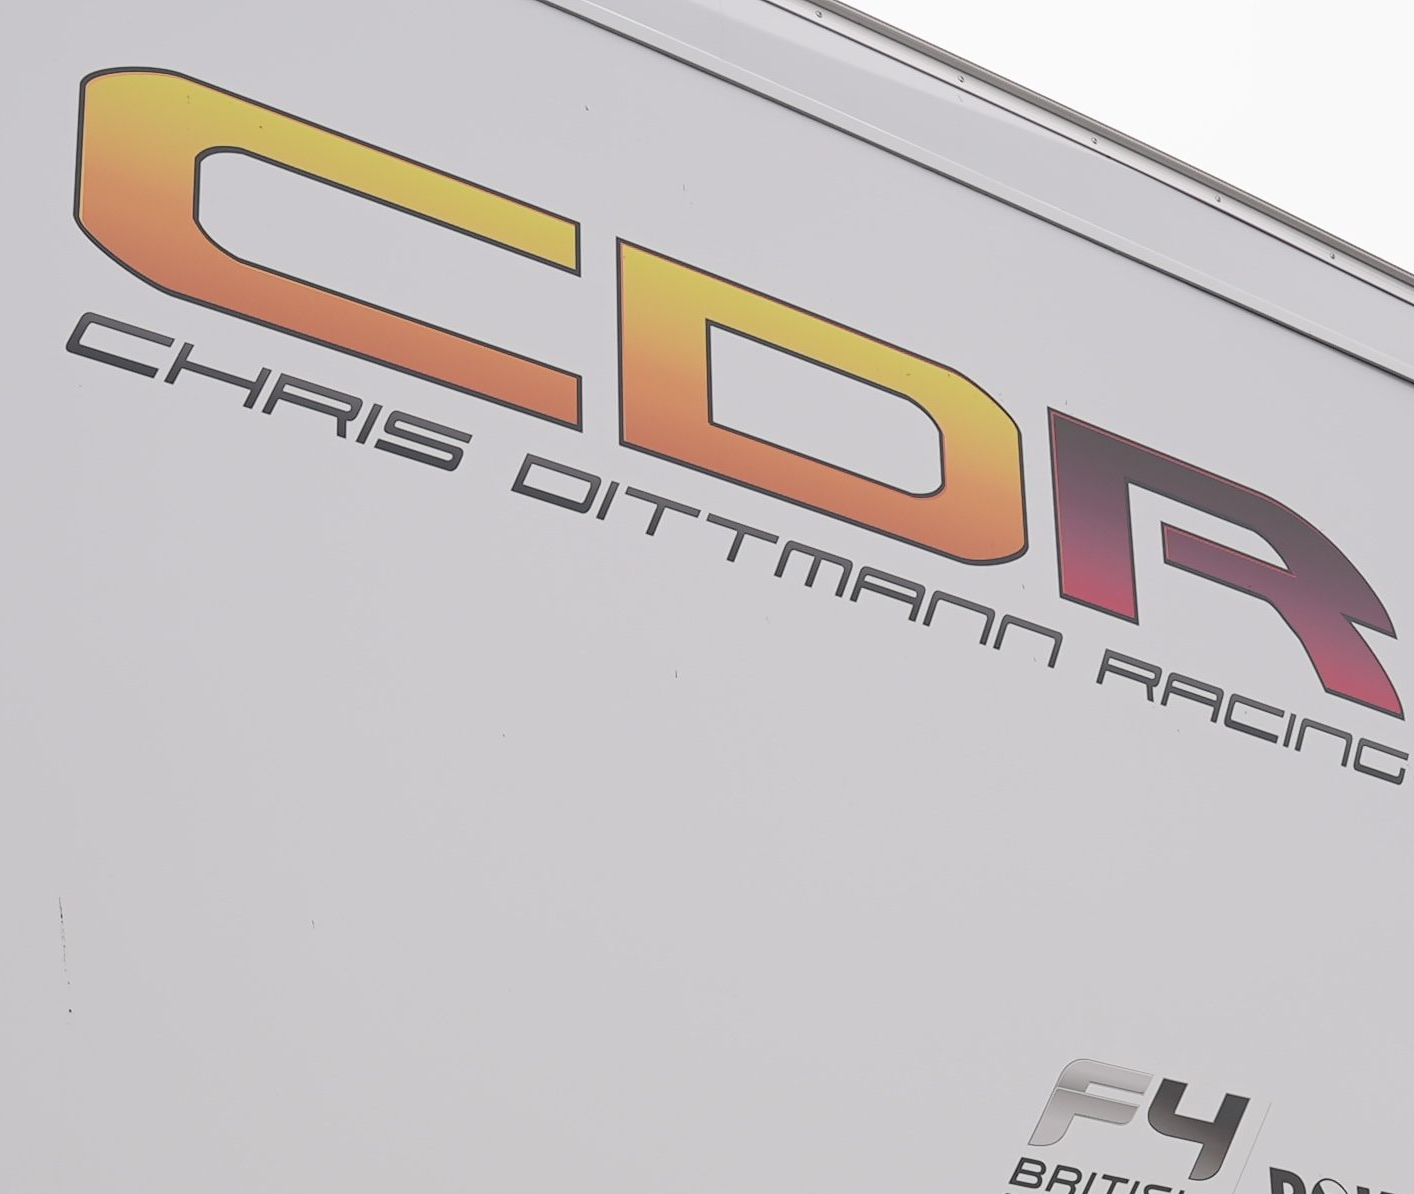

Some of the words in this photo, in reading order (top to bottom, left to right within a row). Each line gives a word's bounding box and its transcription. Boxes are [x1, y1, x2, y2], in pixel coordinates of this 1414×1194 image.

[65, 311, 473, 471] CHRIS
[510, 453, 1063, 668] DITTMANN
[1096, 648, 1409, 785] RACING
[73, 66, 1405, 720] CDR
[1027, 1058, 1251, 1181] F4
